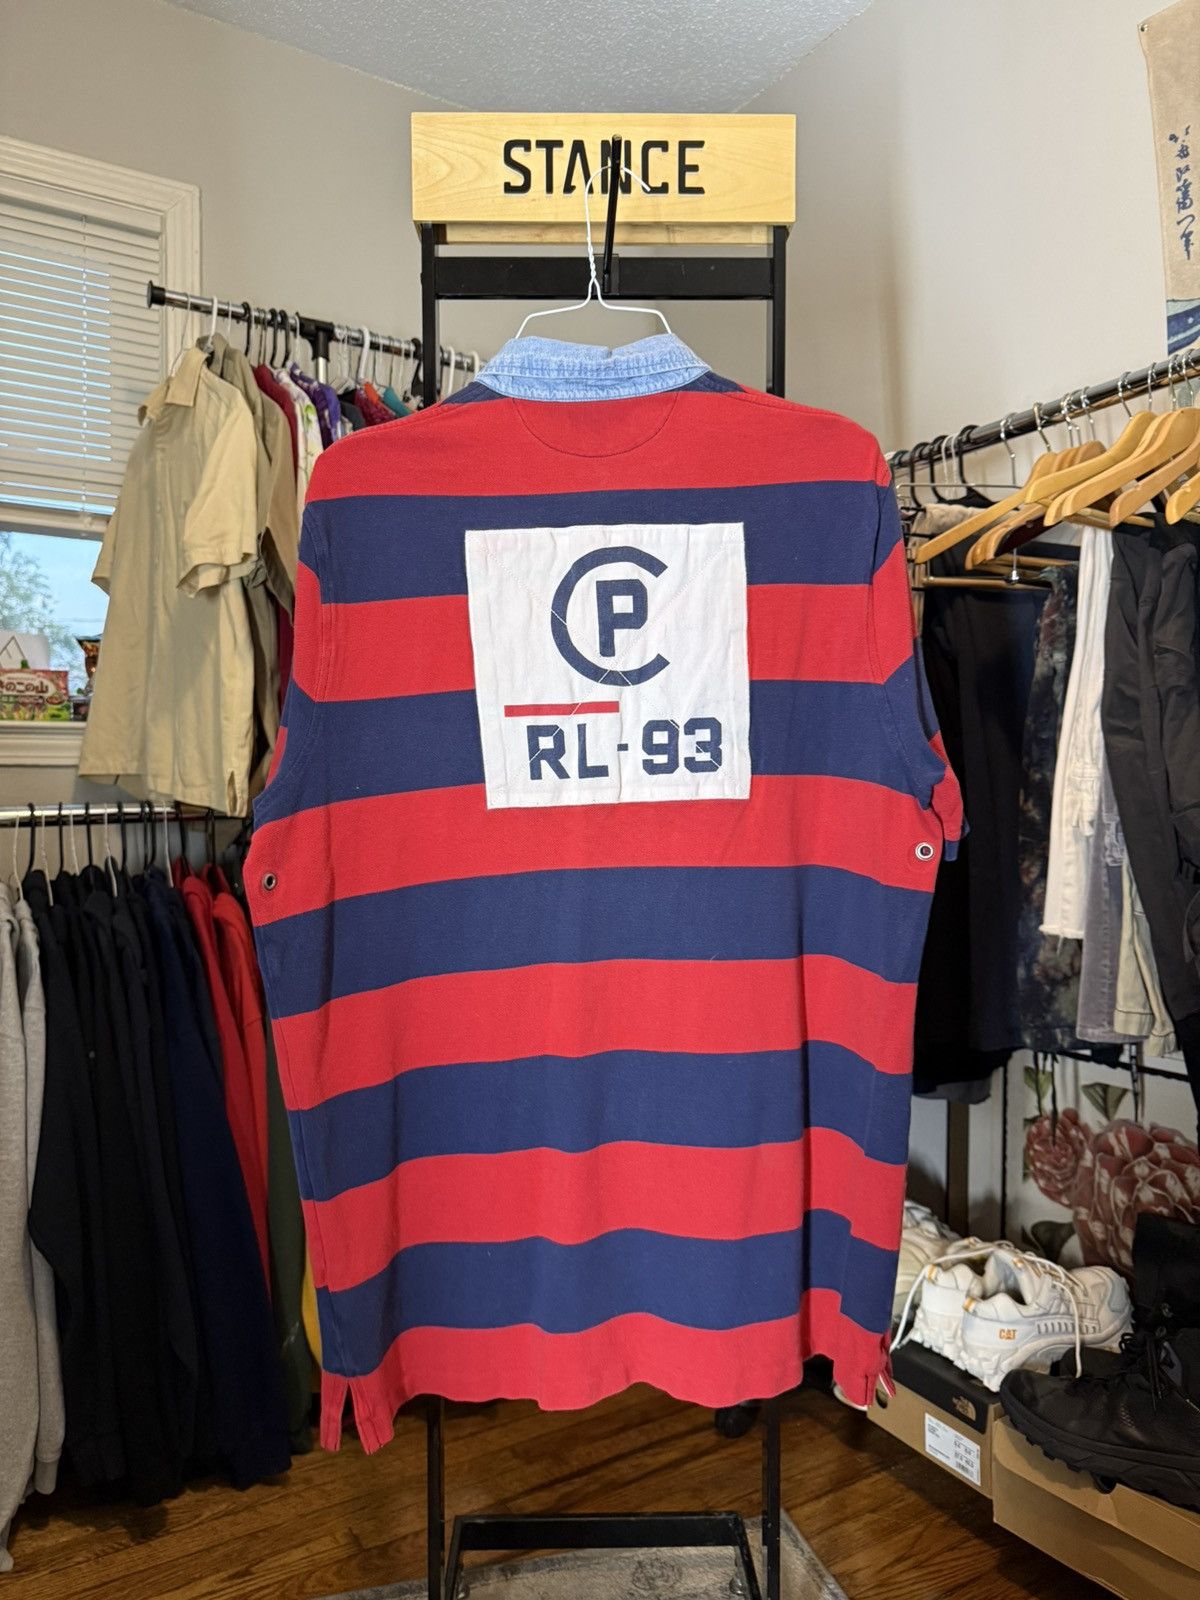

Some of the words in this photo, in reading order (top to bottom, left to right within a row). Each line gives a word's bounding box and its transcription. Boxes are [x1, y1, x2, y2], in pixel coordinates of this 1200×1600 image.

[503, 139, 705, 194] STANCE
[526, 717, 722, 780] RL-93
[999, 1328, 1017, 1340] CAT
